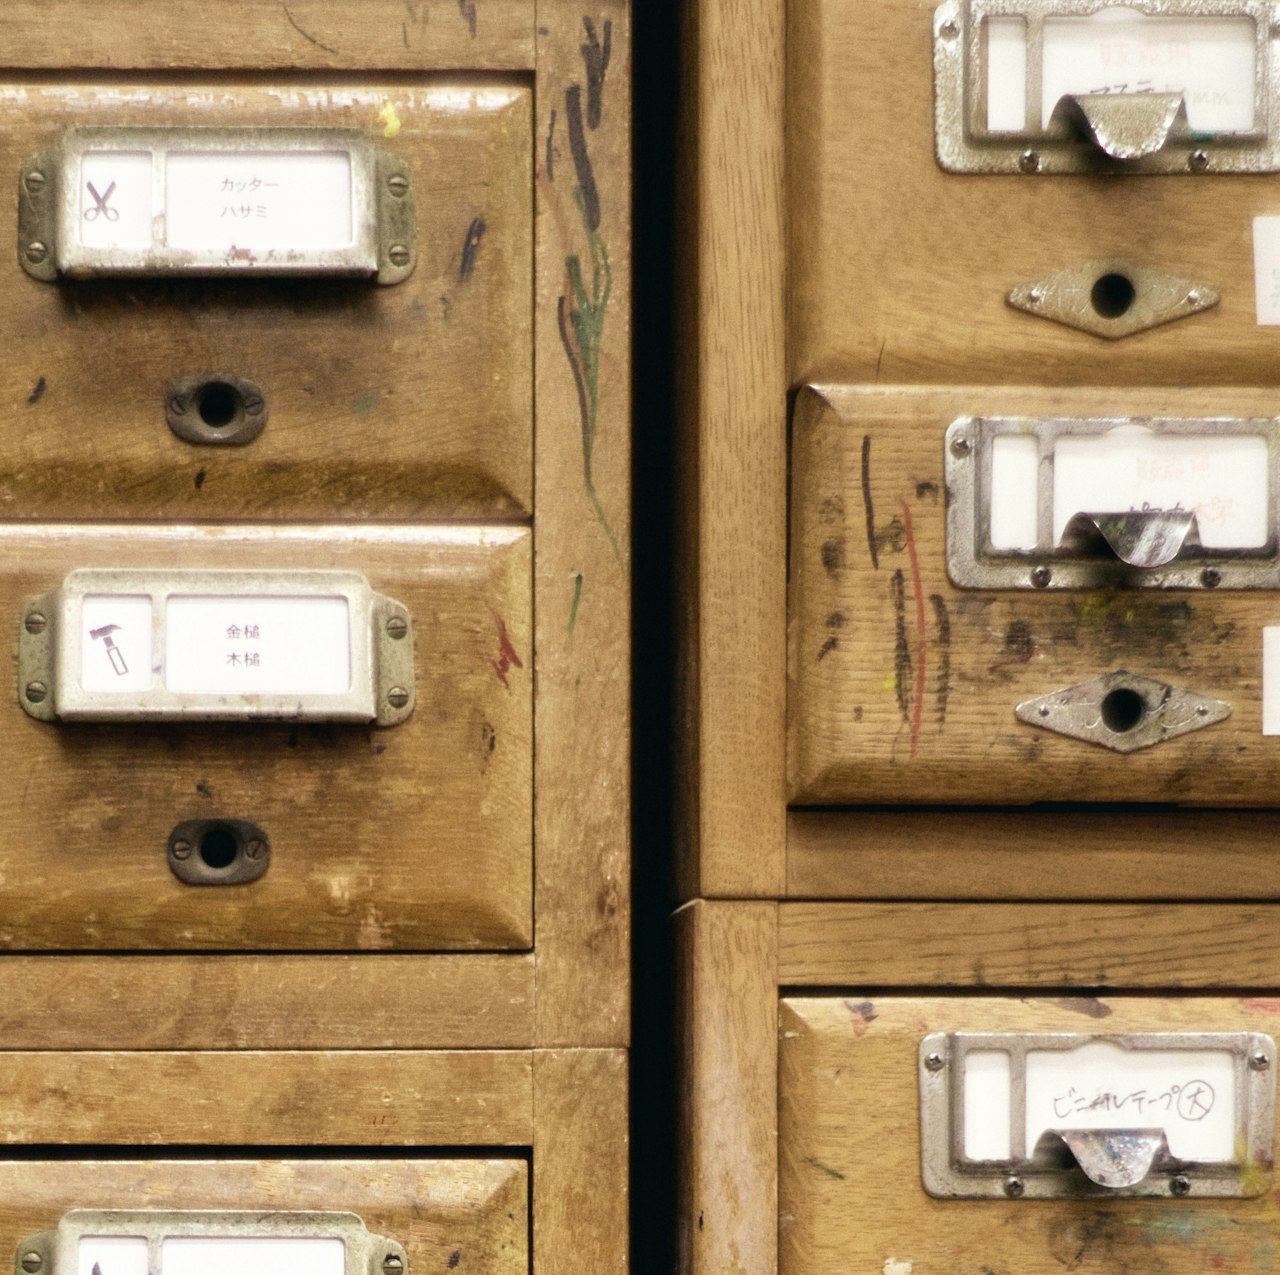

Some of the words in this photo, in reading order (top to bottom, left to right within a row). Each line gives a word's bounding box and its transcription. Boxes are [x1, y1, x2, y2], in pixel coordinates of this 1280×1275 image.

[221, 176, 280, 193] カッター
[221, 203, 269, 220] ハサミ
[225, 622, 262, 641] 金槌
[225, 651, 262, 668] 木槌
